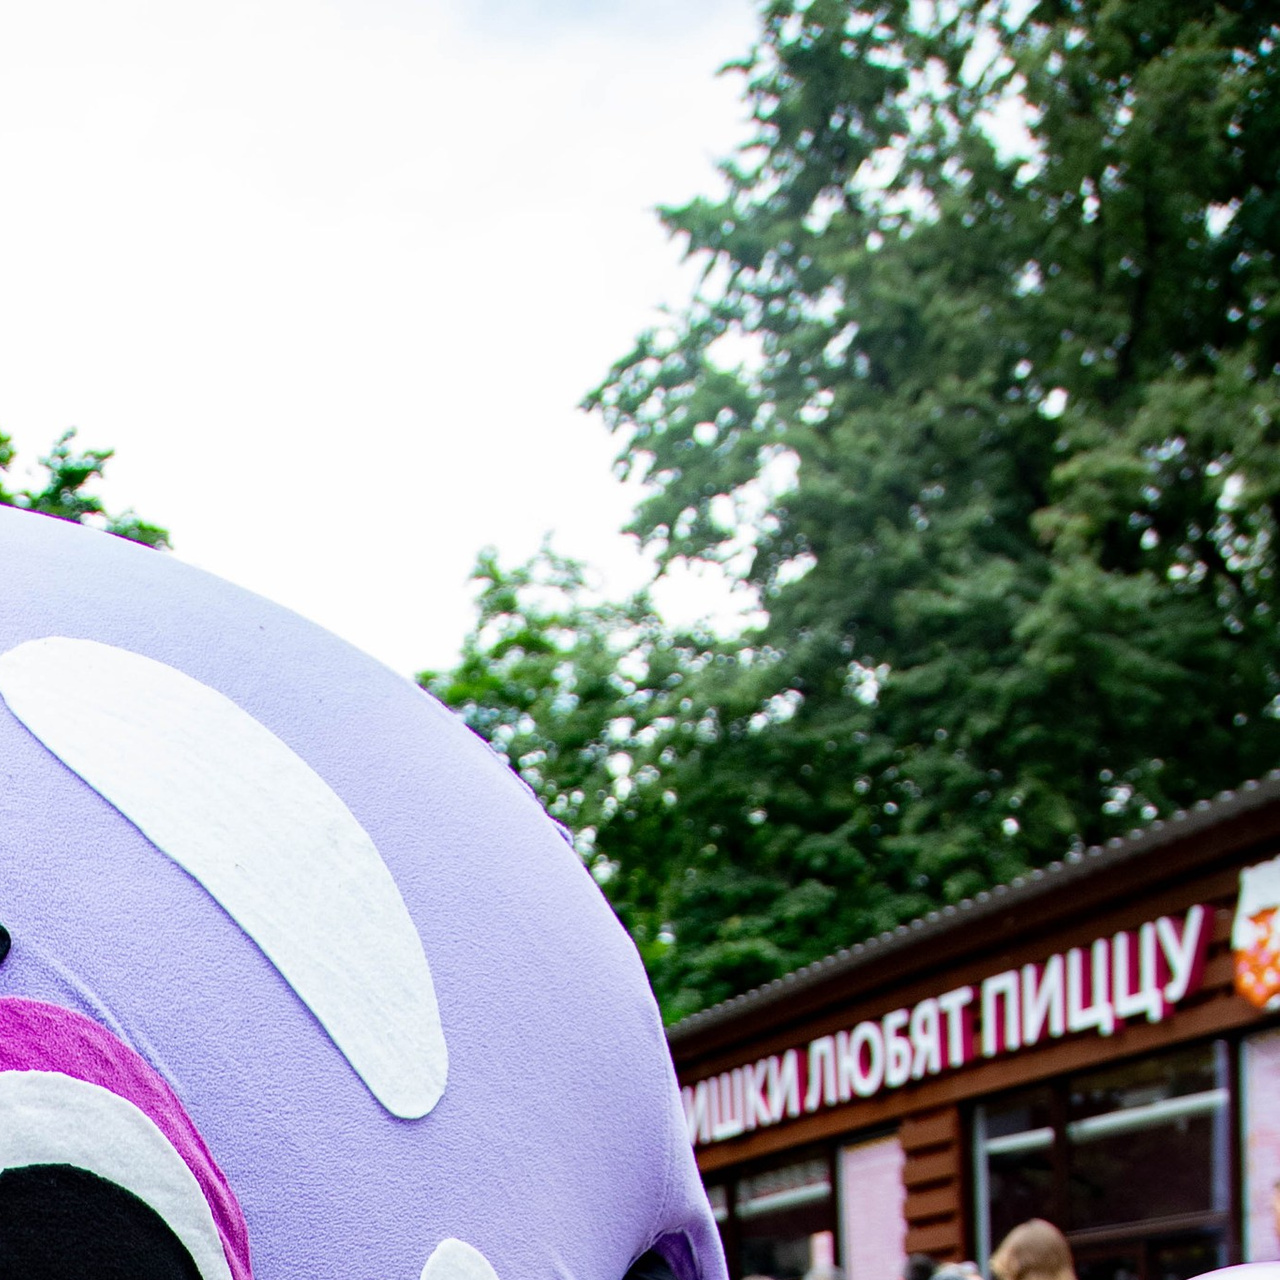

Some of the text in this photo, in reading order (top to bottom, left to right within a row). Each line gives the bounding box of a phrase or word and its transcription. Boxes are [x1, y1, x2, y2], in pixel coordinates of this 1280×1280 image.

[681, 903, 1198, 1146] ИШКИ ЛЮБЯТ ПИЦЦУ
